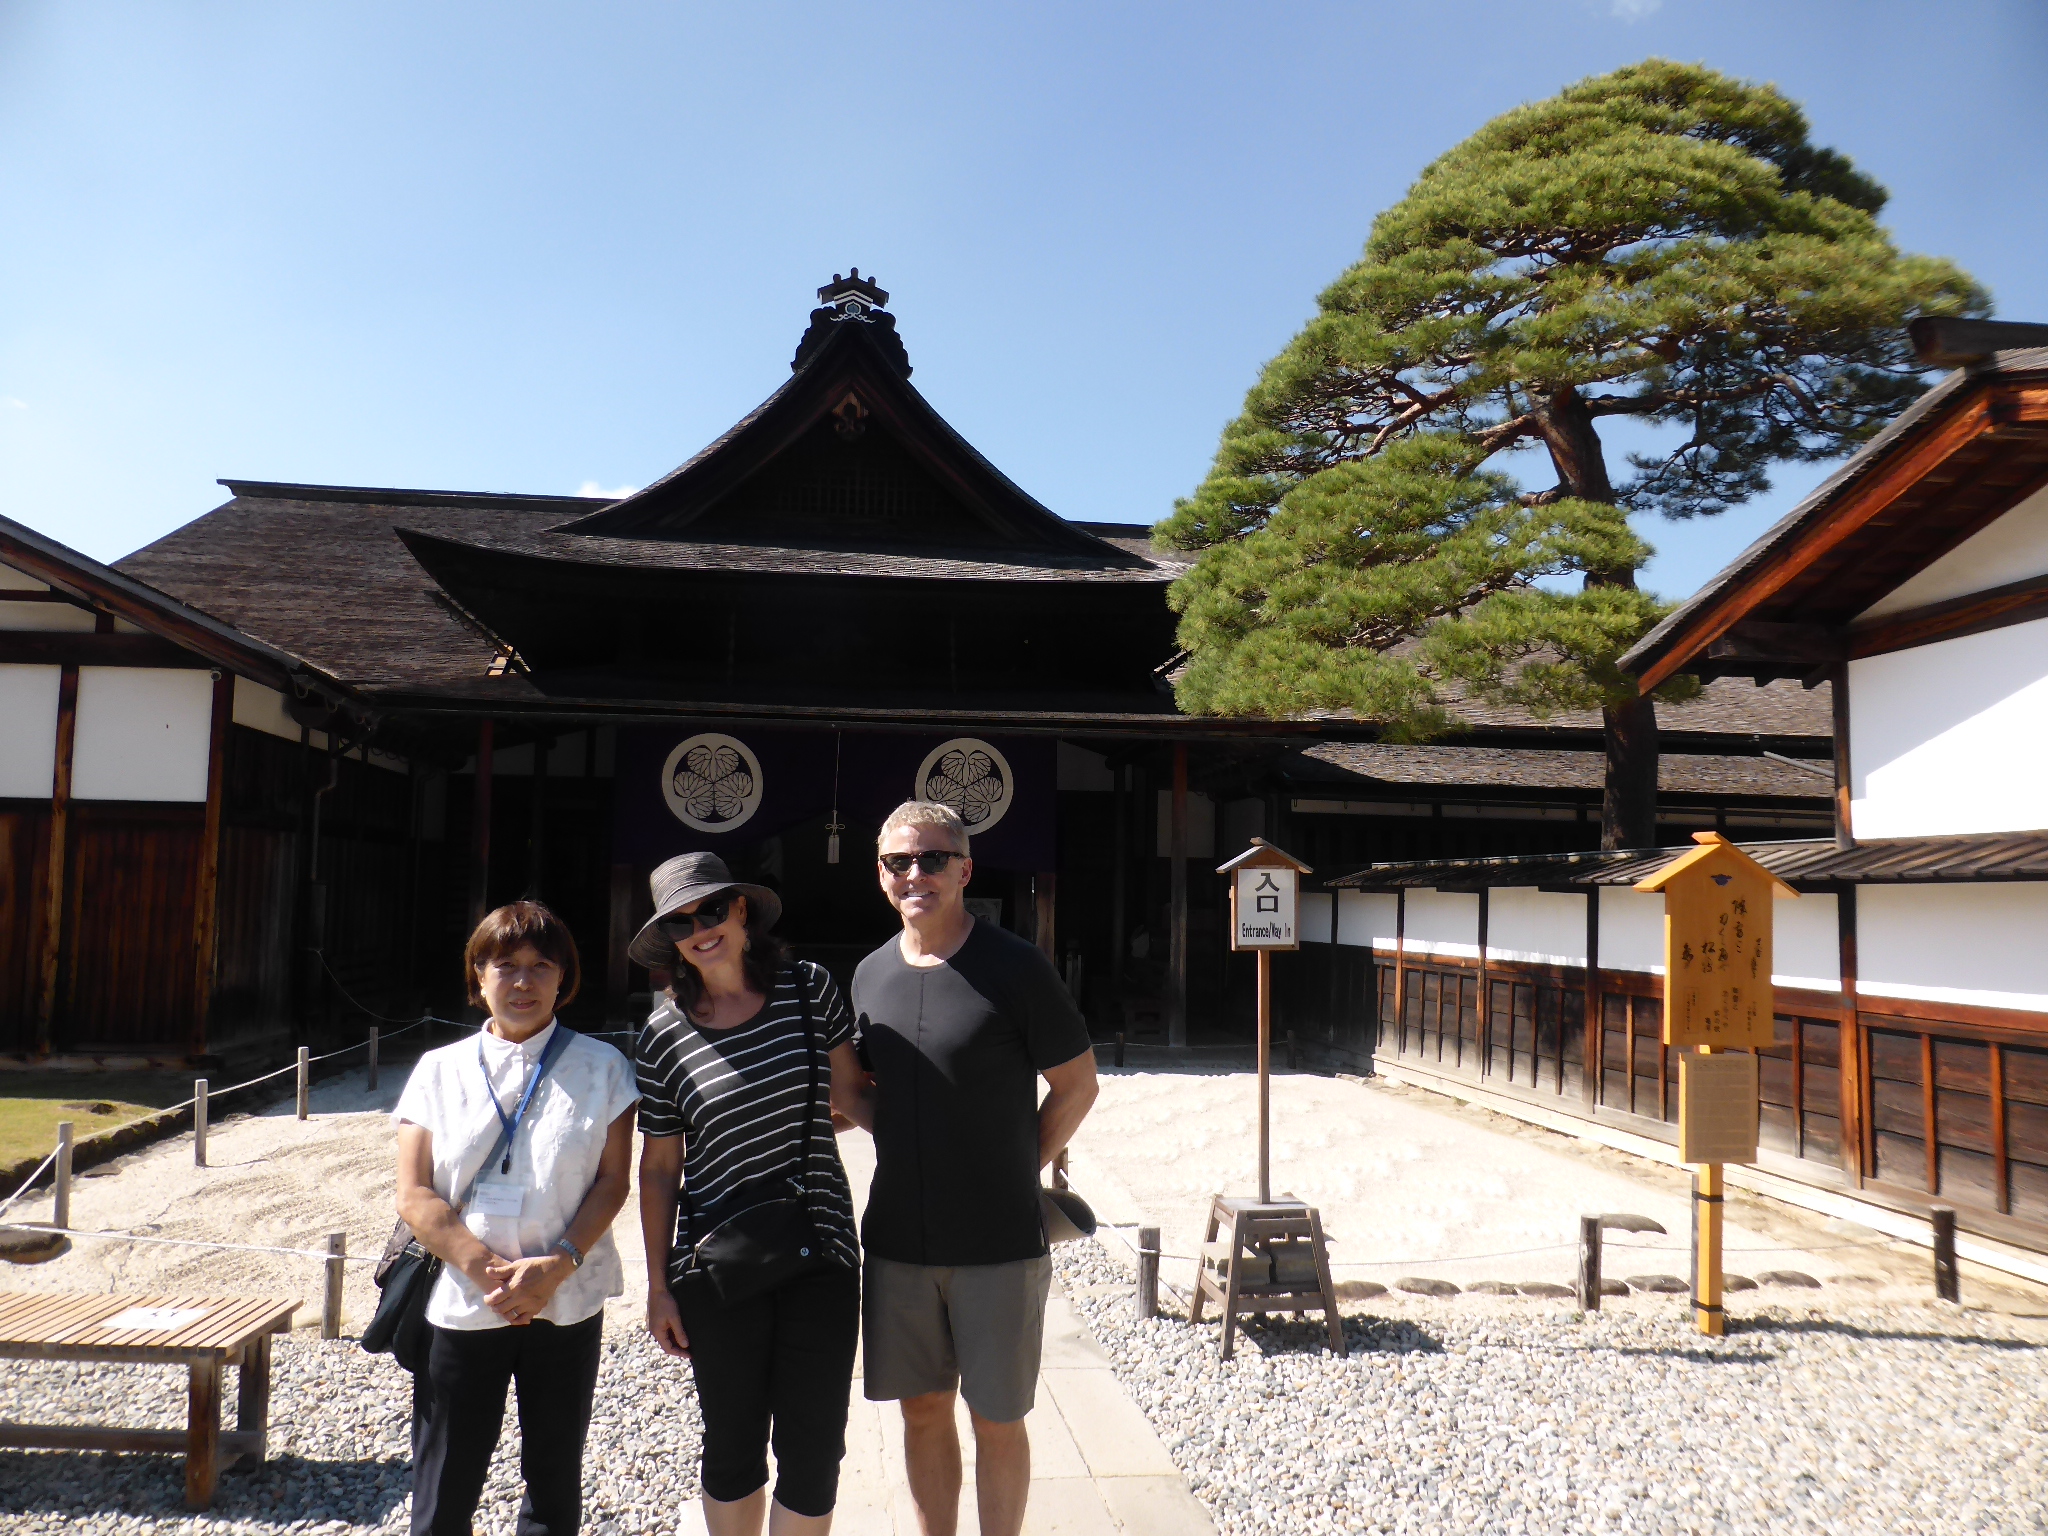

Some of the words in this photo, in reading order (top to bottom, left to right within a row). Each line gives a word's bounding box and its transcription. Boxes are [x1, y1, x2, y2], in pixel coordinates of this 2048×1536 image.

[1255, 872, 1279, 913] 入口
[1242, 921, 1281, 939] Entrance/Way
[1285, 922, 1291, 938] In
